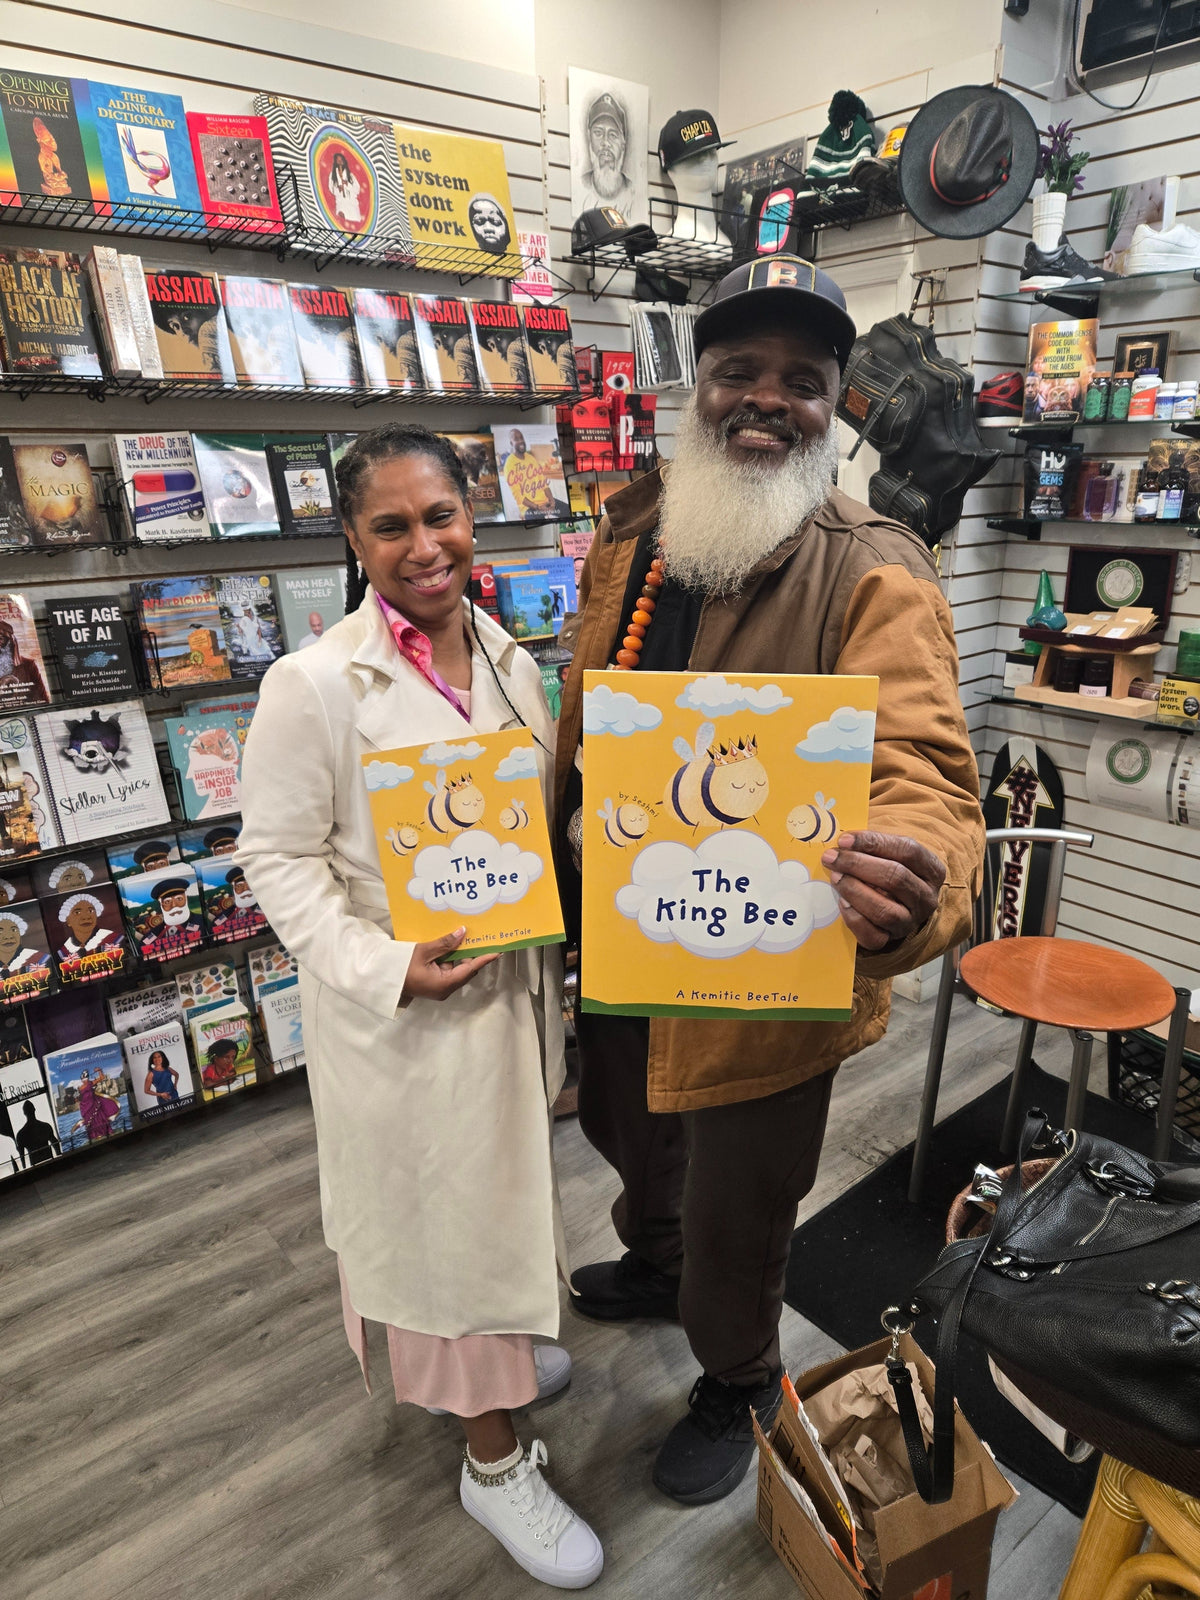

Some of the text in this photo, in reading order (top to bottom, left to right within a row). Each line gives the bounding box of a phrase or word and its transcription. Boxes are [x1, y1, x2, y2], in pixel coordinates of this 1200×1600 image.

[0, 73, 69, 96] OPENING
[3, 91, 70, 112] TO SPIRIT
[121, 91, 148, 104] THE
[108, 99, 165, 117] ADINKRA
[305, 106, 336, 121] PEACE
[98, 107, 176, 130] DICTIONARY
[207, 123, 253, 137] Sixteen
[399, 143, 432, 163] the
[404, 168, 470, 192] system
[409, 192, 454, 212] dont
[413, 216, 467, 237] work
[530, 234, 547, 247] ART
[0, 264, 81, 299] BLACK AF
[767, 261, 797, 287] B
[147, 275, 216, 304] ASSATA
[221, 281, 284, 309] ASSATA
[5, 293, 84, 327] HISTORY
[291, 289, 349, 316] ASSATA
[355, 293, 410, 321] ASSATA
[416, 298, 467, 324] ASSATA
[472, 303, 519, 328] ASSATA
[524, 307, 568, 331] ASSATA
[18, 342, 54, 354] MICHAEL
[607, 361, 632, 373] 1984
[1043, 355, 1066, 363] WISDOM
[123, 436, 189, 450] THE DRUG OF THE
[273, 443, 326, 453] The Secret Life
[125, 448, 192, 460] NEW MILLENNIUM
[296, 452, 317, 460] Plants
[520, 477, 550, 498] Vegan
[1040, 475, 1064, 486] GEMS
[30, 483, 88, 497] MAGIC
[221, 577, 257, 590] HEAL
[286, 578, 336, 590] MAN HEAL
[143, 593, 211, 609] NUTRICIDE
[216, 589, 272, 601] THYSELF
[292, 588, 332, 599] THYSELF
[53, 607, 121, 625] THE AGE
[71, 626, 112, 643] OF AI
[542, 676, 559, 686] GAN
[1161, 695, 1178, 703] dont
[1162, 687, 1187, 696] system
[1160, 703, 1181, 711] work
[195, 767, 235, 780] HAPPINESS
[204, 775, 237, 790] INSIDE
[60, 779, 150, 815] Stellar Lyrics
[215, 787, 233, 799] JOB
[619, 791, 660, 817] by Seshmi
[450, 856, 486, 873] The
[434, 872, 518, 900] King Bee
[692, 869, 750, 893] The
[656, 898, 797, 937] King Bee
[465, 934, 496, 945] Kemitic
[60, 948, 124, 983] MARY
[0, 968, 51, 998] ARY
[115, 986, 175, 1008] SCHOOL OF
[117, 1003, 138, 1015] HARD
[142, 993, 177, 1007] KNOCKS
[676, 990, 685, 998] A
[691, 990, 740, 1001] Kemitic
[203, 1020, 247, 1040] VISITOR
[130, 1035, 180, 1055] HEALING
[8, 1080, 40, 1098] Racism
